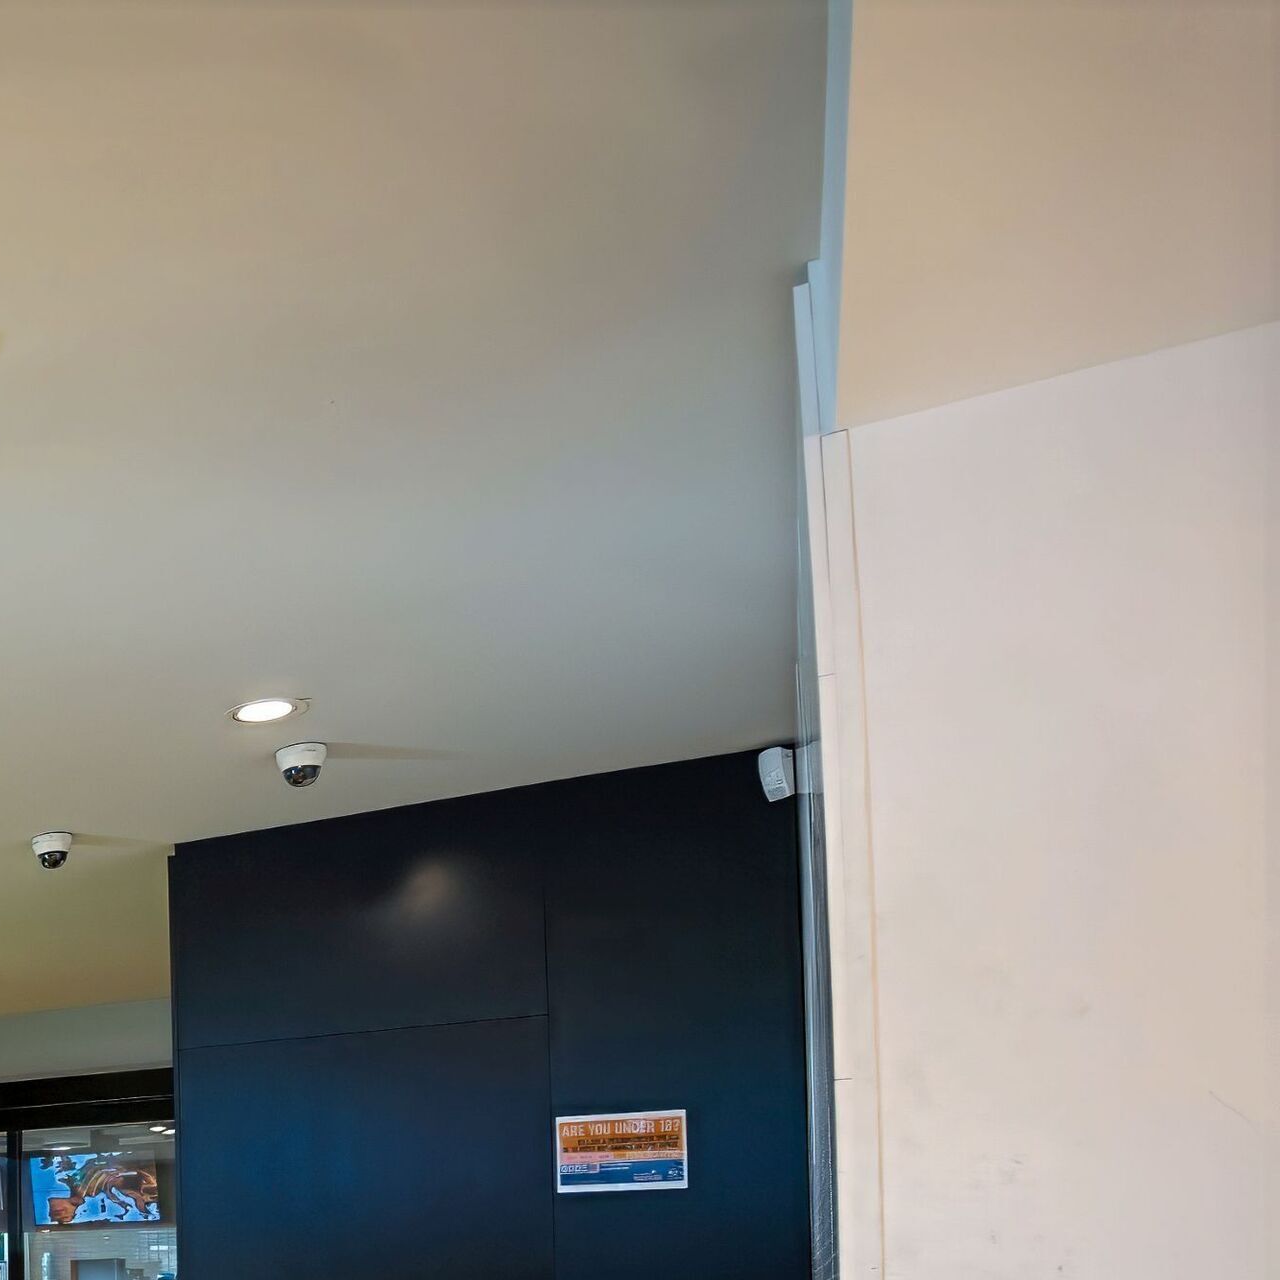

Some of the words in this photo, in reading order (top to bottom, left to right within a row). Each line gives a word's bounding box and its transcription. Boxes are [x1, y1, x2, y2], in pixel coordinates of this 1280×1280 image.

[562, 1125, 586, 1136] ARE
[588, 1122, 611, 1136] YOU
[614, 1119, 655, 1134] UNDER
